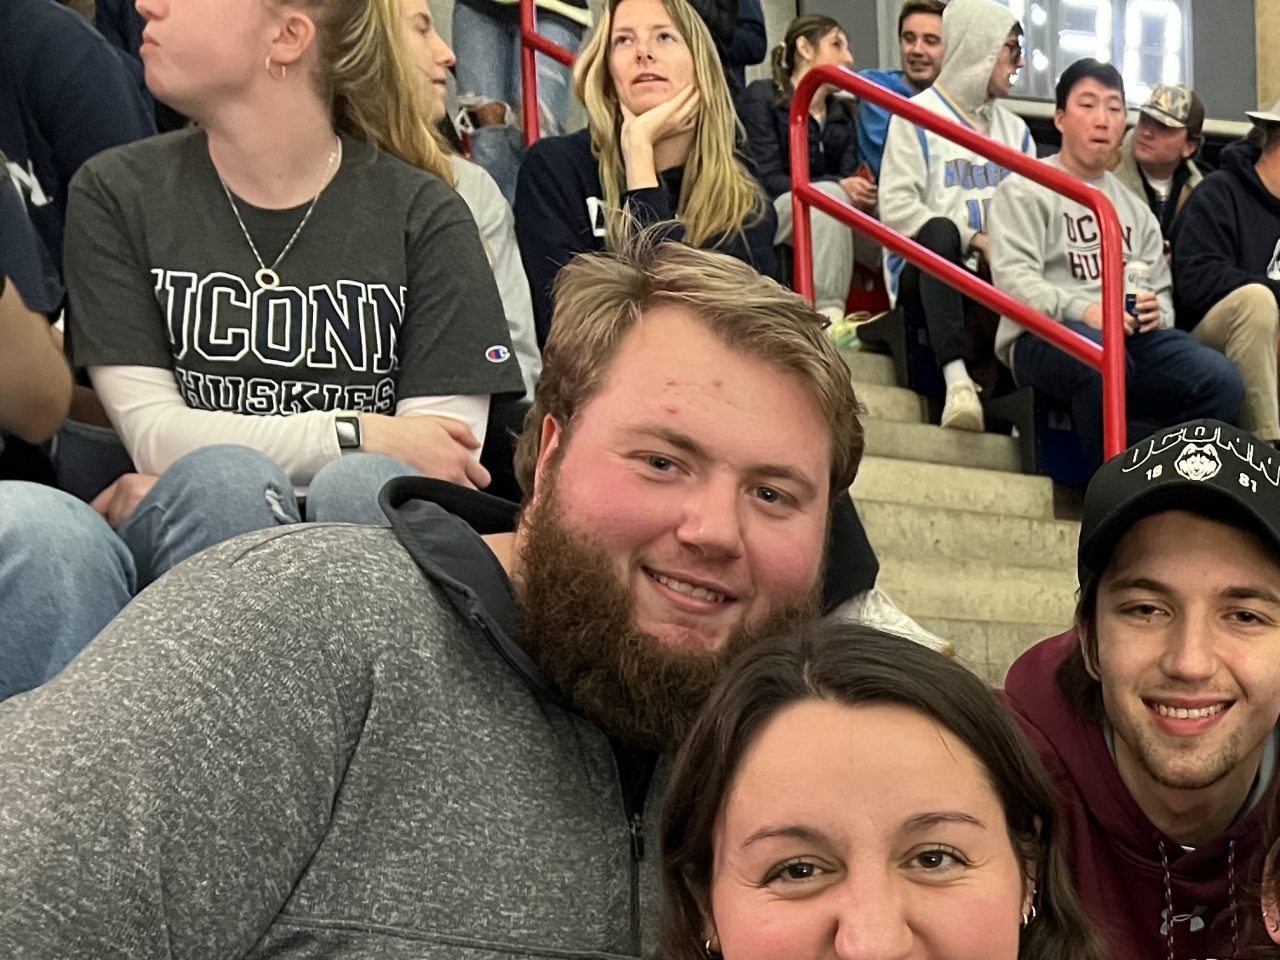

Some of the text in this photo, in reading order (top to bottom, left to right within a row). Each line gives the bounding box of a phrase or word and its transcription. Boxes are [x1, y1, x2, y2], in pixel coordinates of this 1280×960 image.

[1122, 426, 1280, 488] UCONN
[1146, 464, 1257, 493] 18 81
